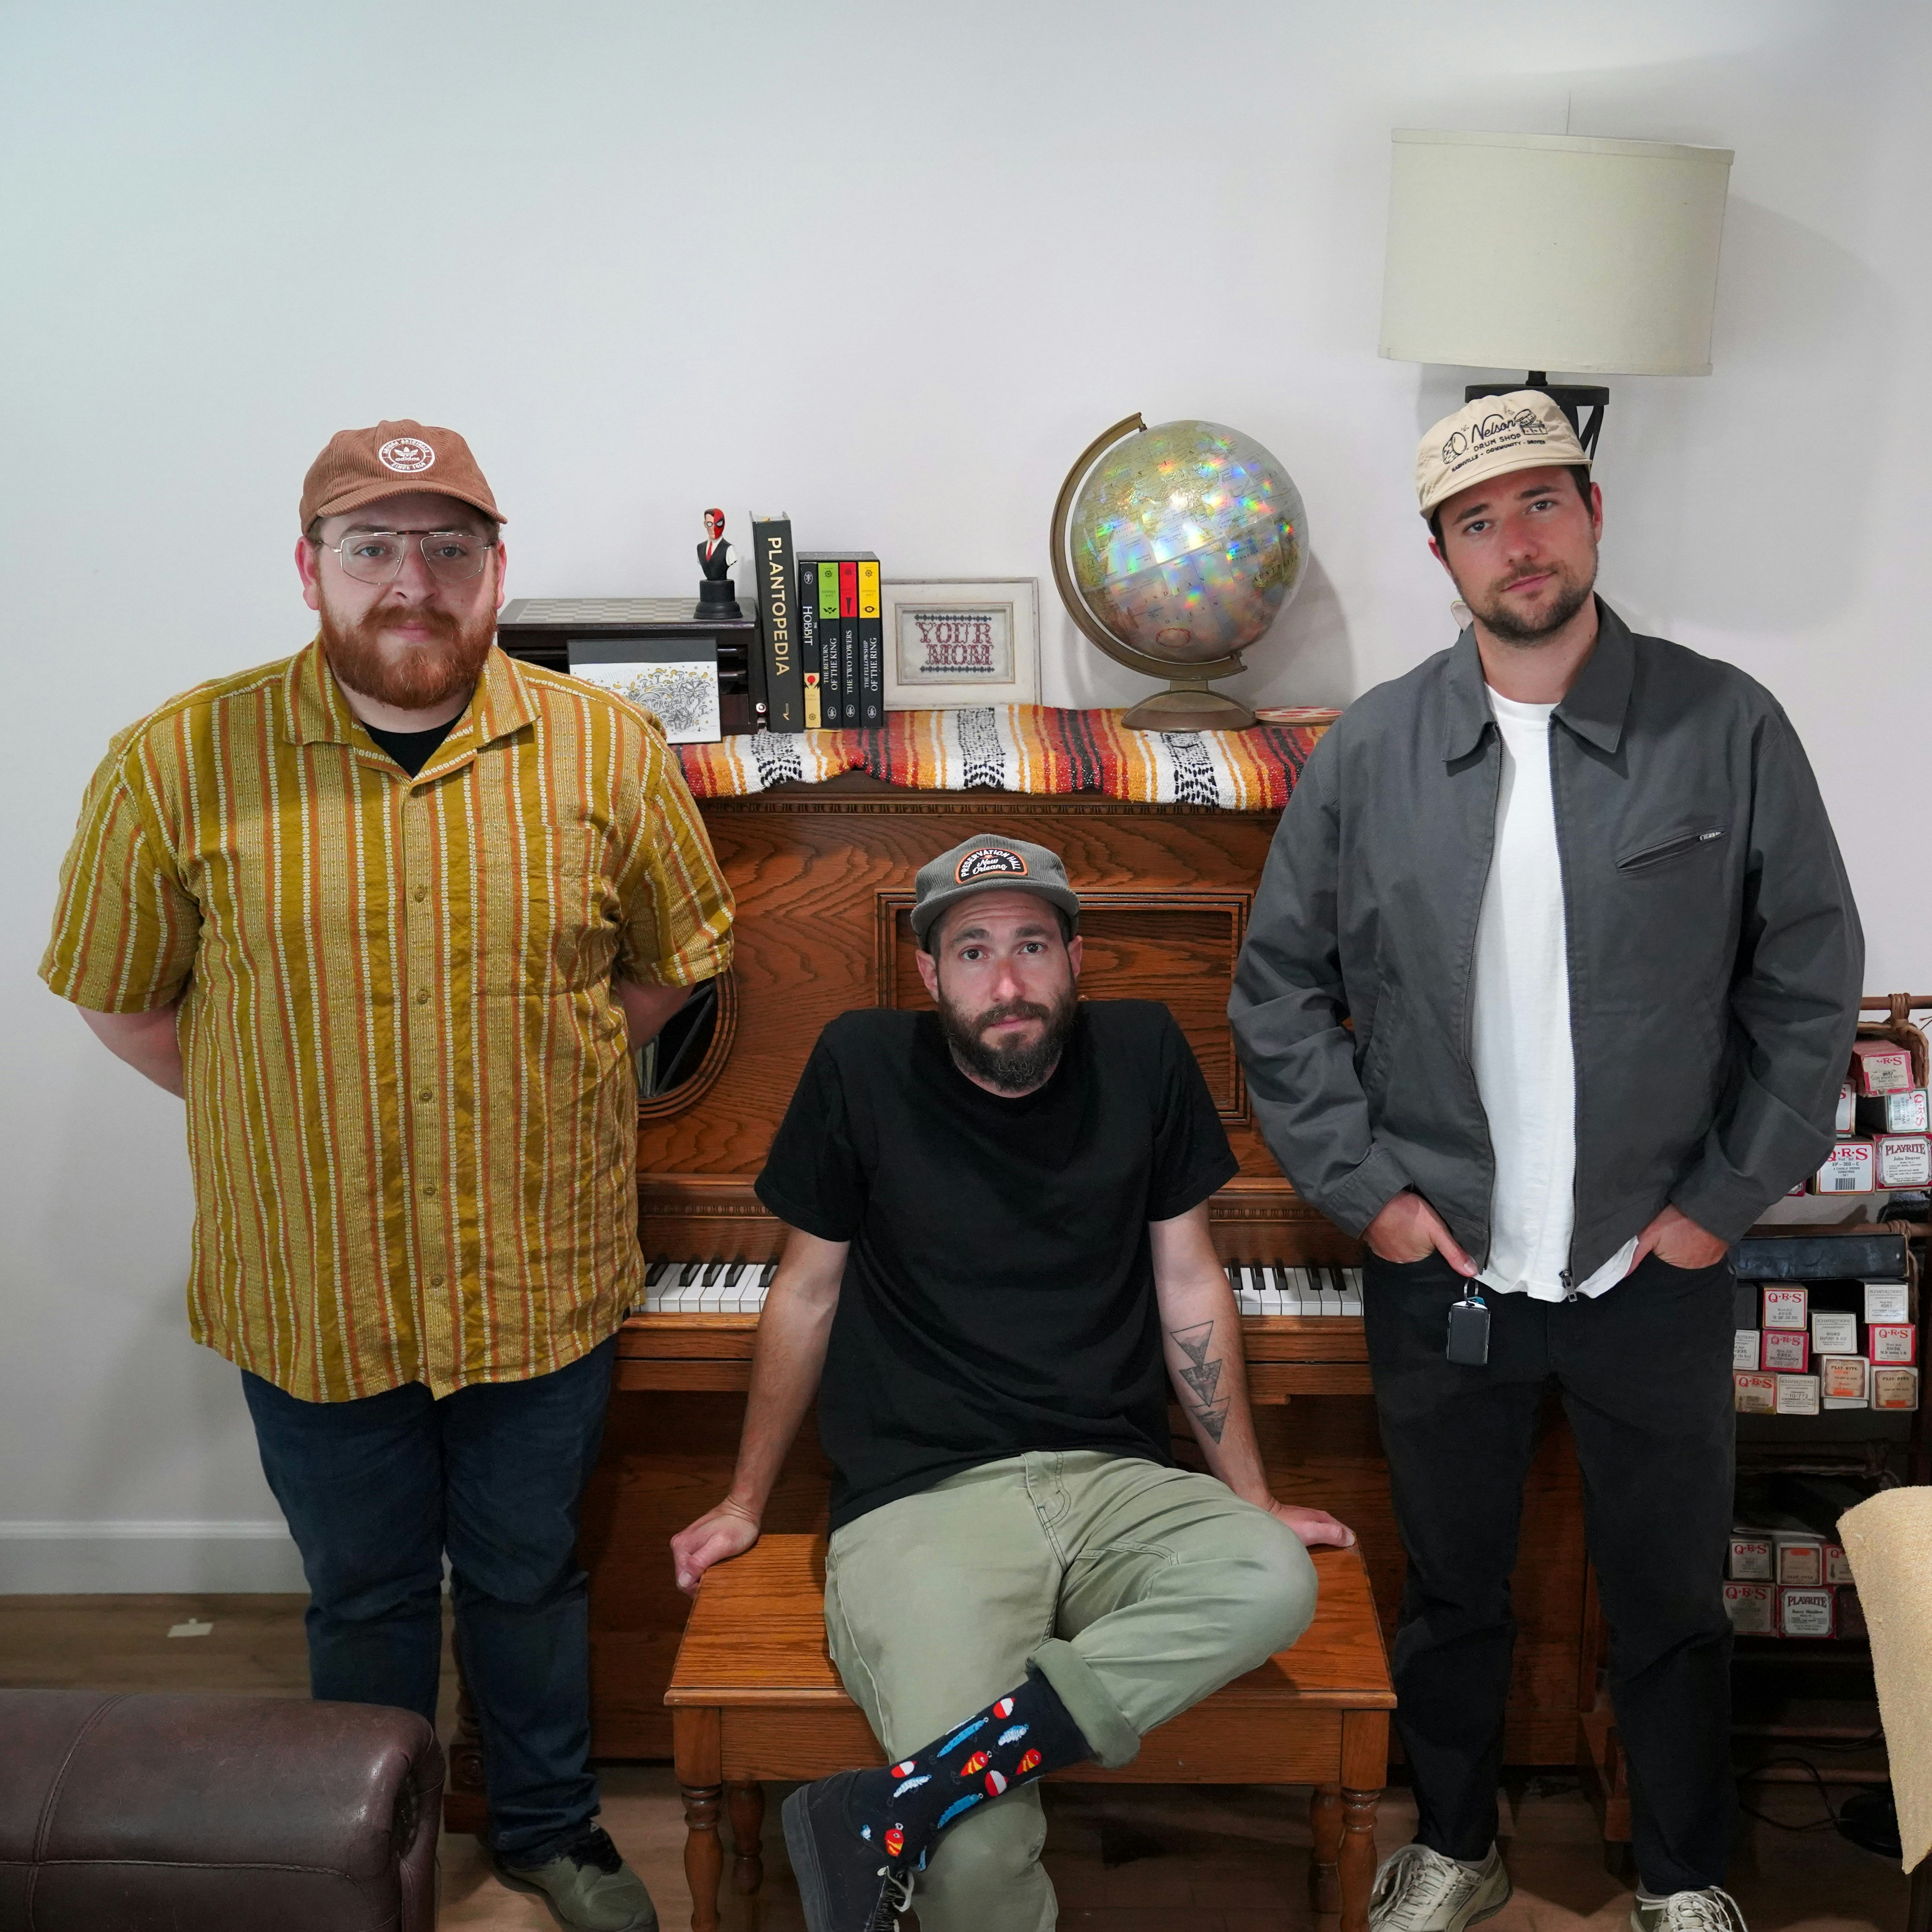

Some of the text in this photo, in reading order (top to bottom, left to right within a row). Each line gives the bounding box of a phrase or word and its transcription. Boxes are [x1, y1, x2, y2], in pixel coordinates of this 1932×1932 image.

[1472, 414, 1516, 443] Nelson
[1474, 433, 1521, 452] DRUM SHOP
[1451, 454, 1479, 472] NASHVILLE
[1486, 441, 1521, 454] COMMUNITY
[768, 537, 789, 676] PLANTOPEDIA
[803, 606, 813, 646] HOBBIT
[915, 622, 992, 643] YOUR
[926, 644, 994, 665] MOM
[831, 680, 838, 690] OF
[870, 680, 878, 691] OF
[961, 850, 1021, 877] PRESERVATION HALL
[972, 864, 1007, 875] Orleans
[977, 859, 998, 867] New
